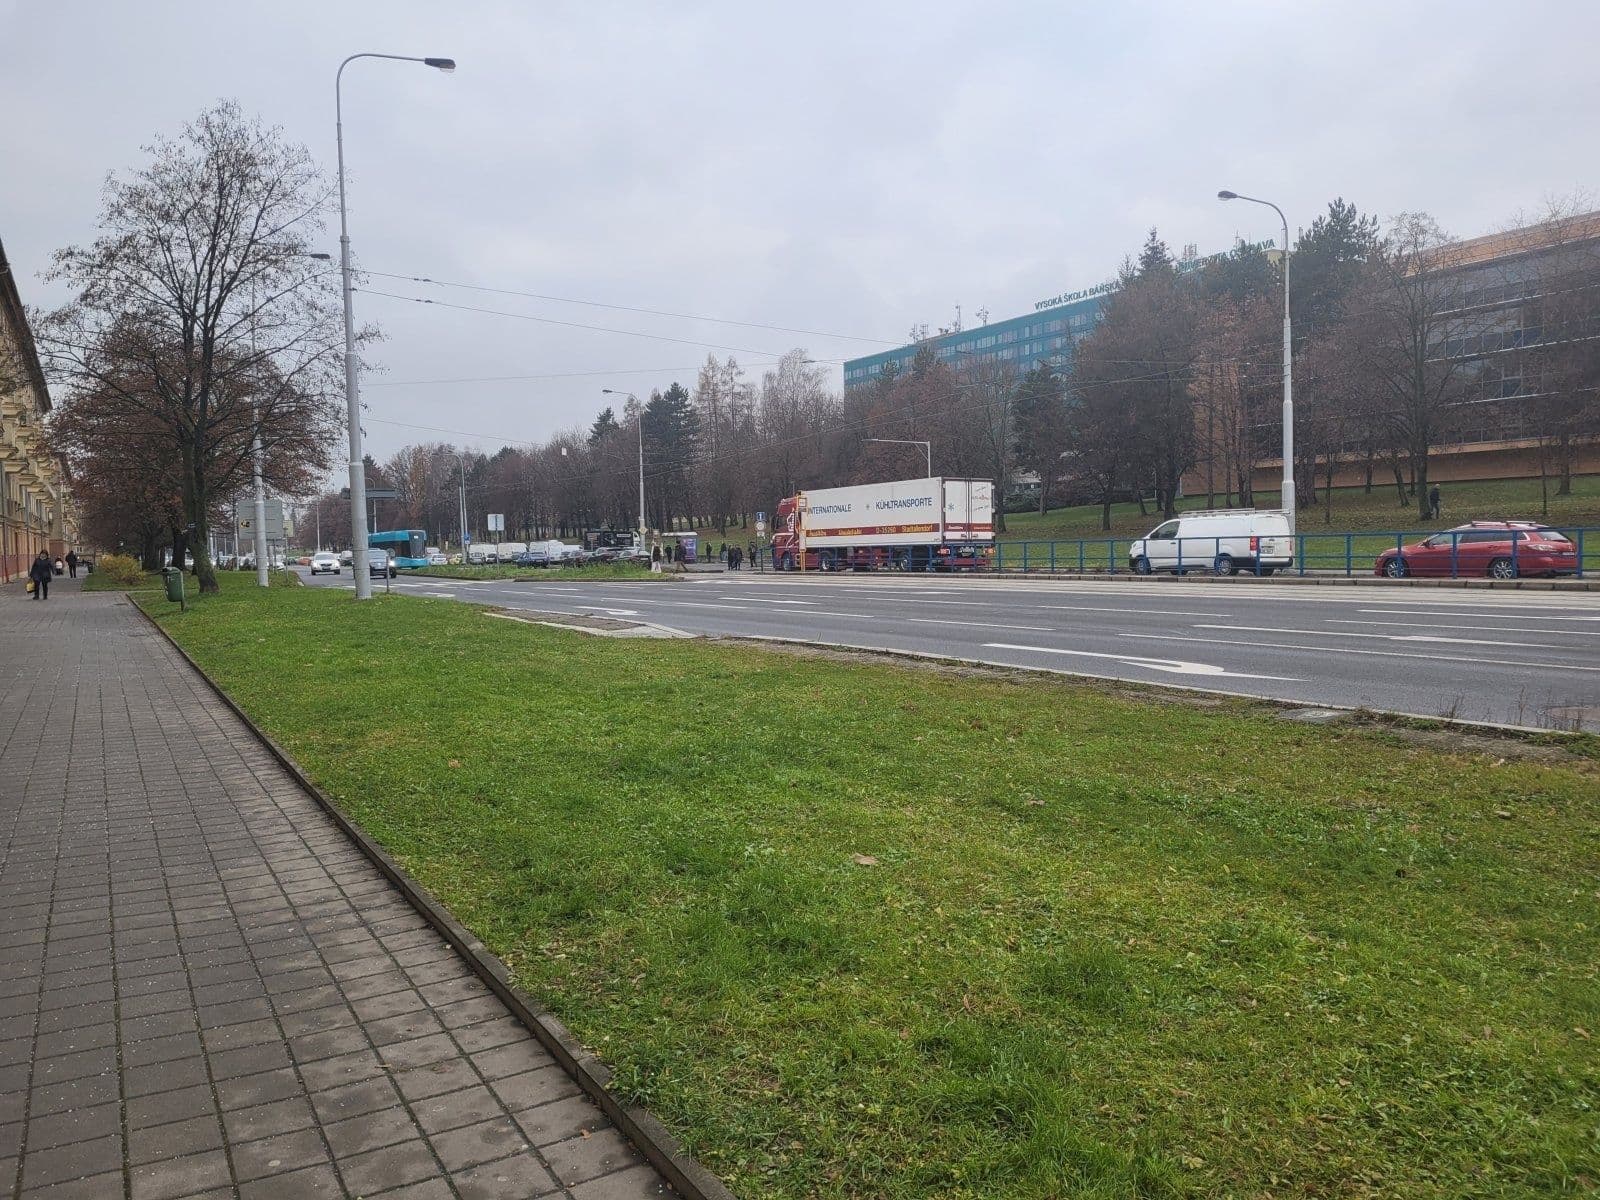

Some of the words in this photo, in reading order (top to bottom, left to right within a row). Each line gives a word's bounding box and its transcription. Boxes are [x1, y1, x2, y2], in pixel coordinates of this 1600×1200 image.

[1034, 294, 1063, 310] VYSOKÁ
[1063, 290, 1088, 303] ŠKOLA
[875, 497, 933, 511] KÜHLTRANSPORTE
